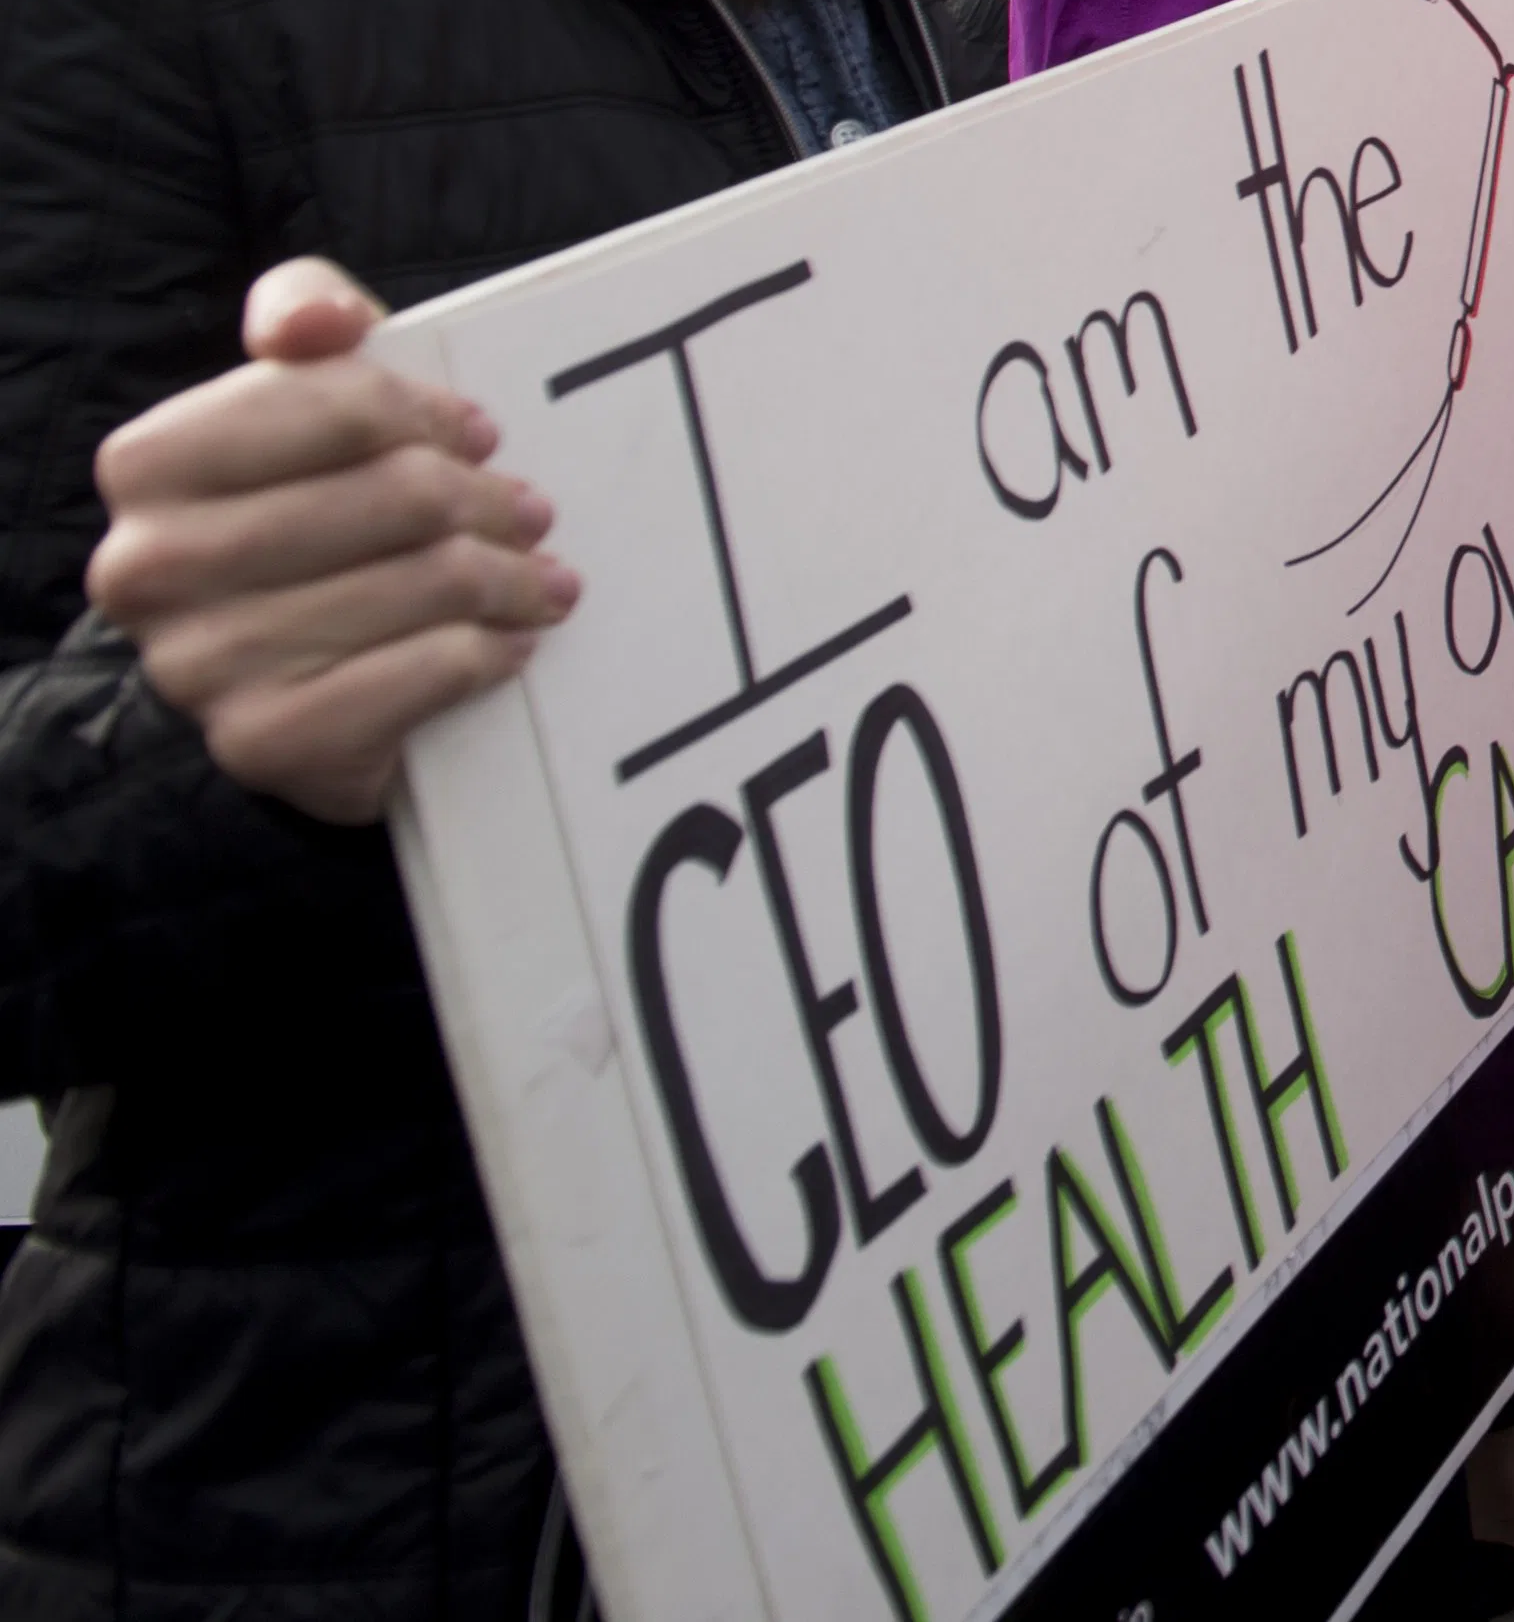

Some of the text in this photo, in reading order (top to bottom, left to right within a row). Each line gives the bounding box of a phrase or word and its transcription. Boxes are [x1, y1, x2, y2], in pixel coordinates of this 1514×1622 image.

[545, 49, 1414, 786] I am the
[625, 681, 1003, 1337] CEO
[1088, 547, 1210, 1008] of
[1275, 610, 1440, 883] my
[803, 929, 1350, 1622] HEALTH
